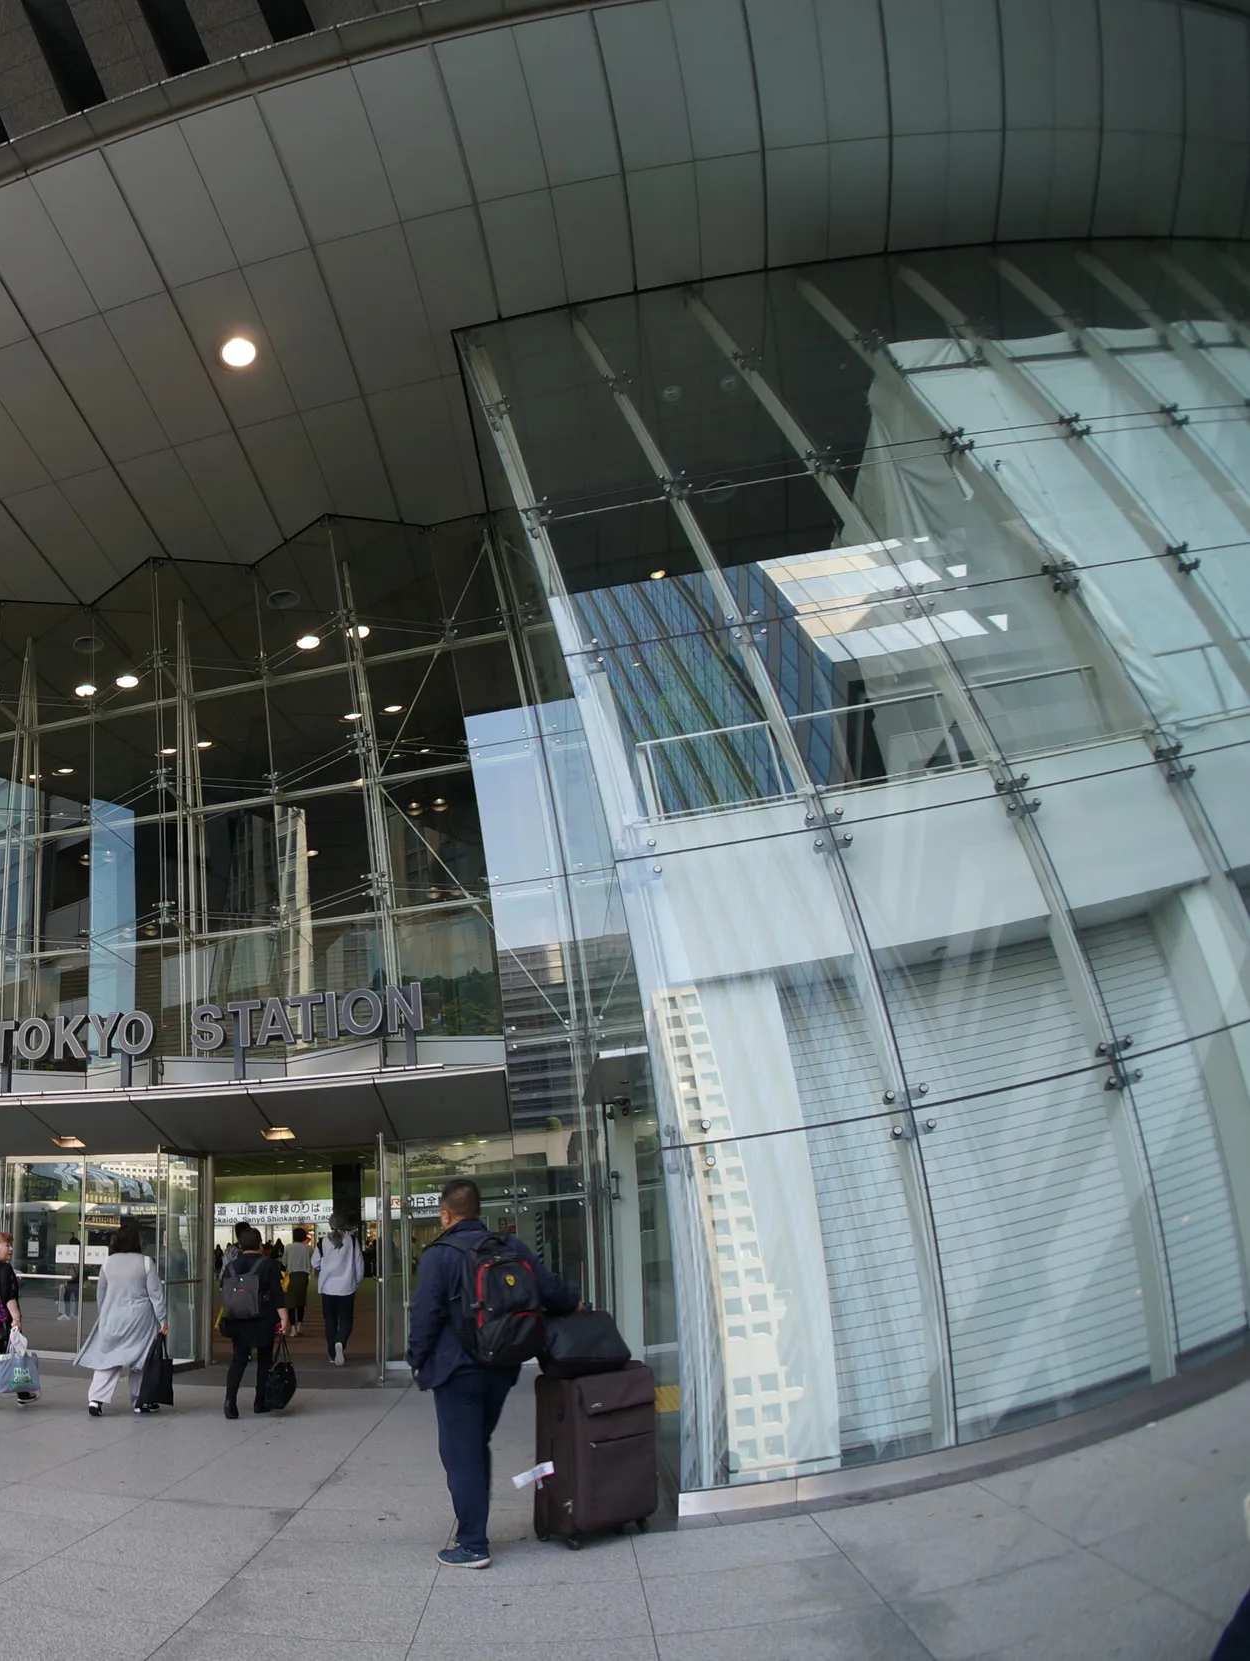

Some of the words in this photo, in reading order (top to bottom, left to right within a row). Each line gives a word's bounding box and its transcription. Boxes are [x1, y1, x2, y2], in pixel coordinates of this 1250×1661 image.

[191, 982, 424, 1052] STATION
[215, 1202, 321, 1216] 道・山陽新幹線のりば
[267, 1214, 311, 1223] Shinkansen
[314, 1213, 331, 1221] Trac
